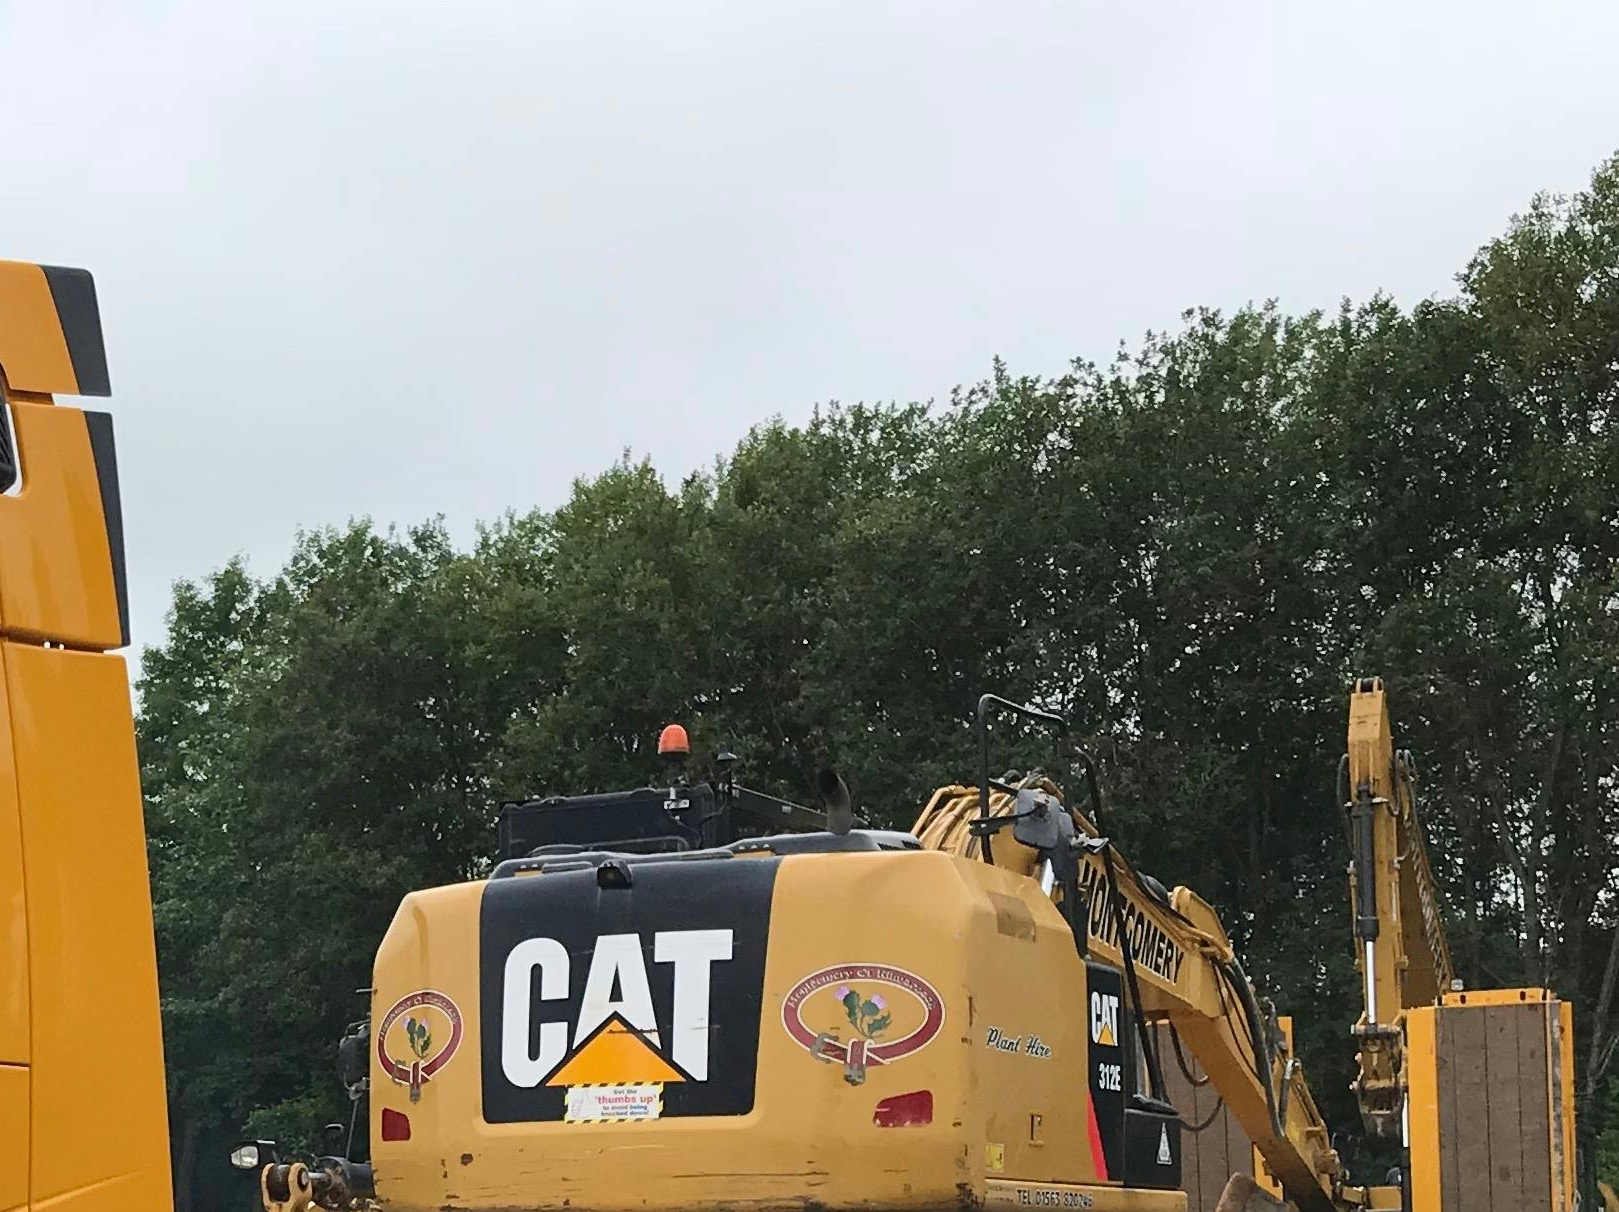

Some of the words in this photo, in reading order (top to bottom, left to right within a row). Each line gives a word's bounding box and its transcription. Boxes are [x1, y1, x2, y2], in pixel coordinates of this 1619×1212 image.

[501, 929, 734, 1088] CAT
[1091, 991, 1119, 1047] CAT
[986, 1027, 1021, 1053] Plant
[1025, 1035, 1051, 1058] Hire
[1098, 1062, 1122, 1092] 312E
[1016, 1189, 1032, 1206] TEL
